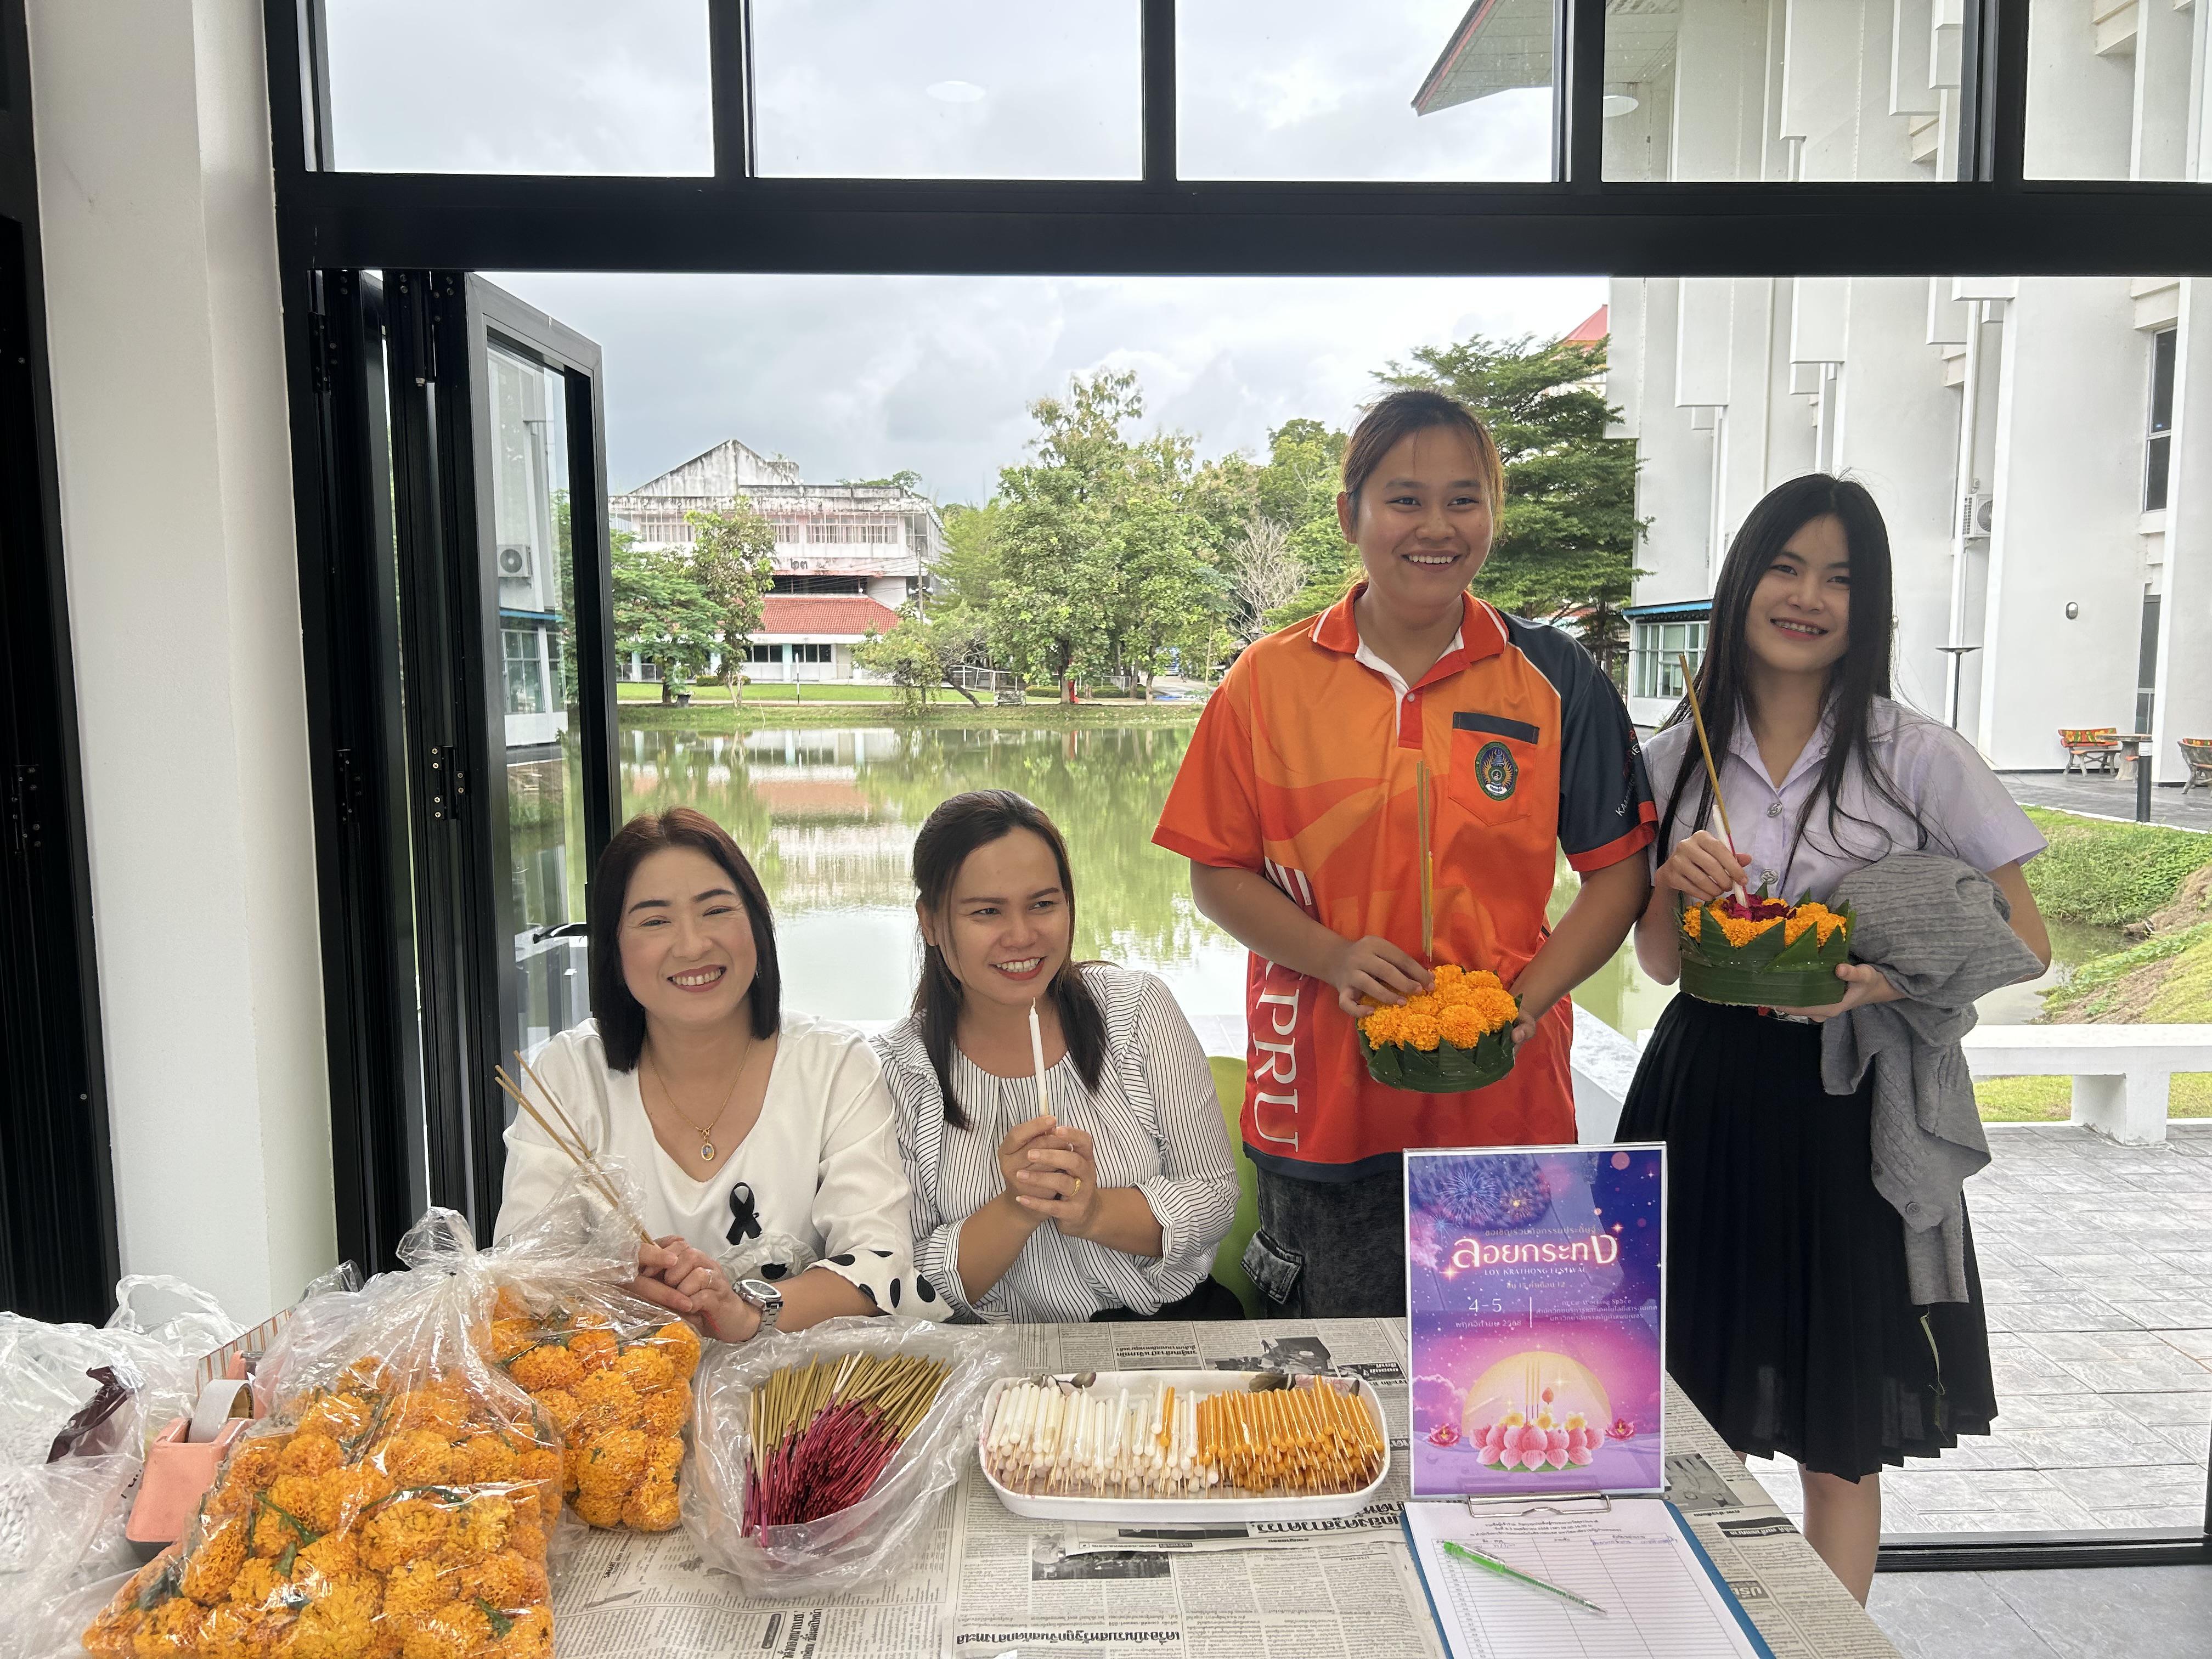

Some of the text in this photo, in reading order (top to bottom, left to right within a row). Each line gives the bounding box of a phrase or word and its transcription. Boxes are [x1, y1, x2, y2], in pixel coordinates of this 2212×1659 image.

[1453, 1234, 1618, 1268] ลอยกระทง
[1503, 1268, 1548, 1276] KRATHONG
[956, 1630, 1180, 1645] เครื่องบินรบสหรัฐถูกจีนสกัดกลางทะเล
